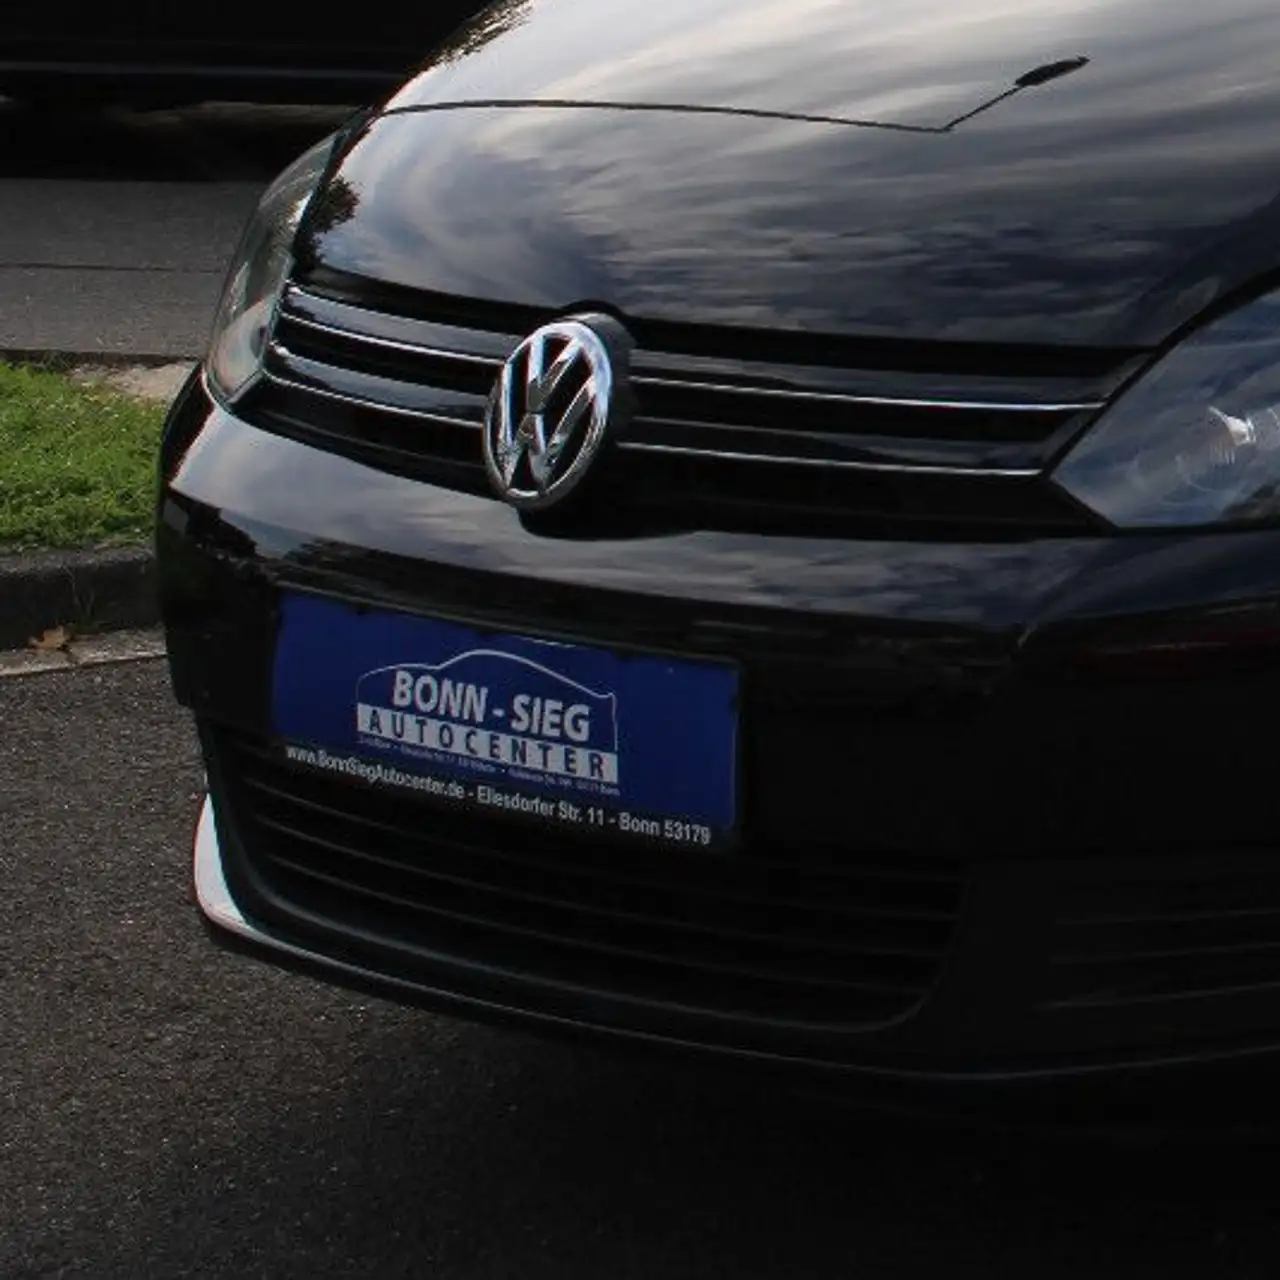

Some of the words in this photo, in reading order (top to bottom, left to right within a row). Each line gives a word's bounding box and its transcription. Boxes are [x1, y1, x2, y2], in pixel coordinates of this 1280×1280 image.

[391, 669, 488, 724] BONN
[510, 693, 590, 742] SIEG
[367, 708, 605, 778] AUTOCENTER
[558, 799, 583, 823] Str.
[587, 806, 605, 827] 11
[618, 811, 661, 837] Bonn
[664, 819, 712, 846] 53179
